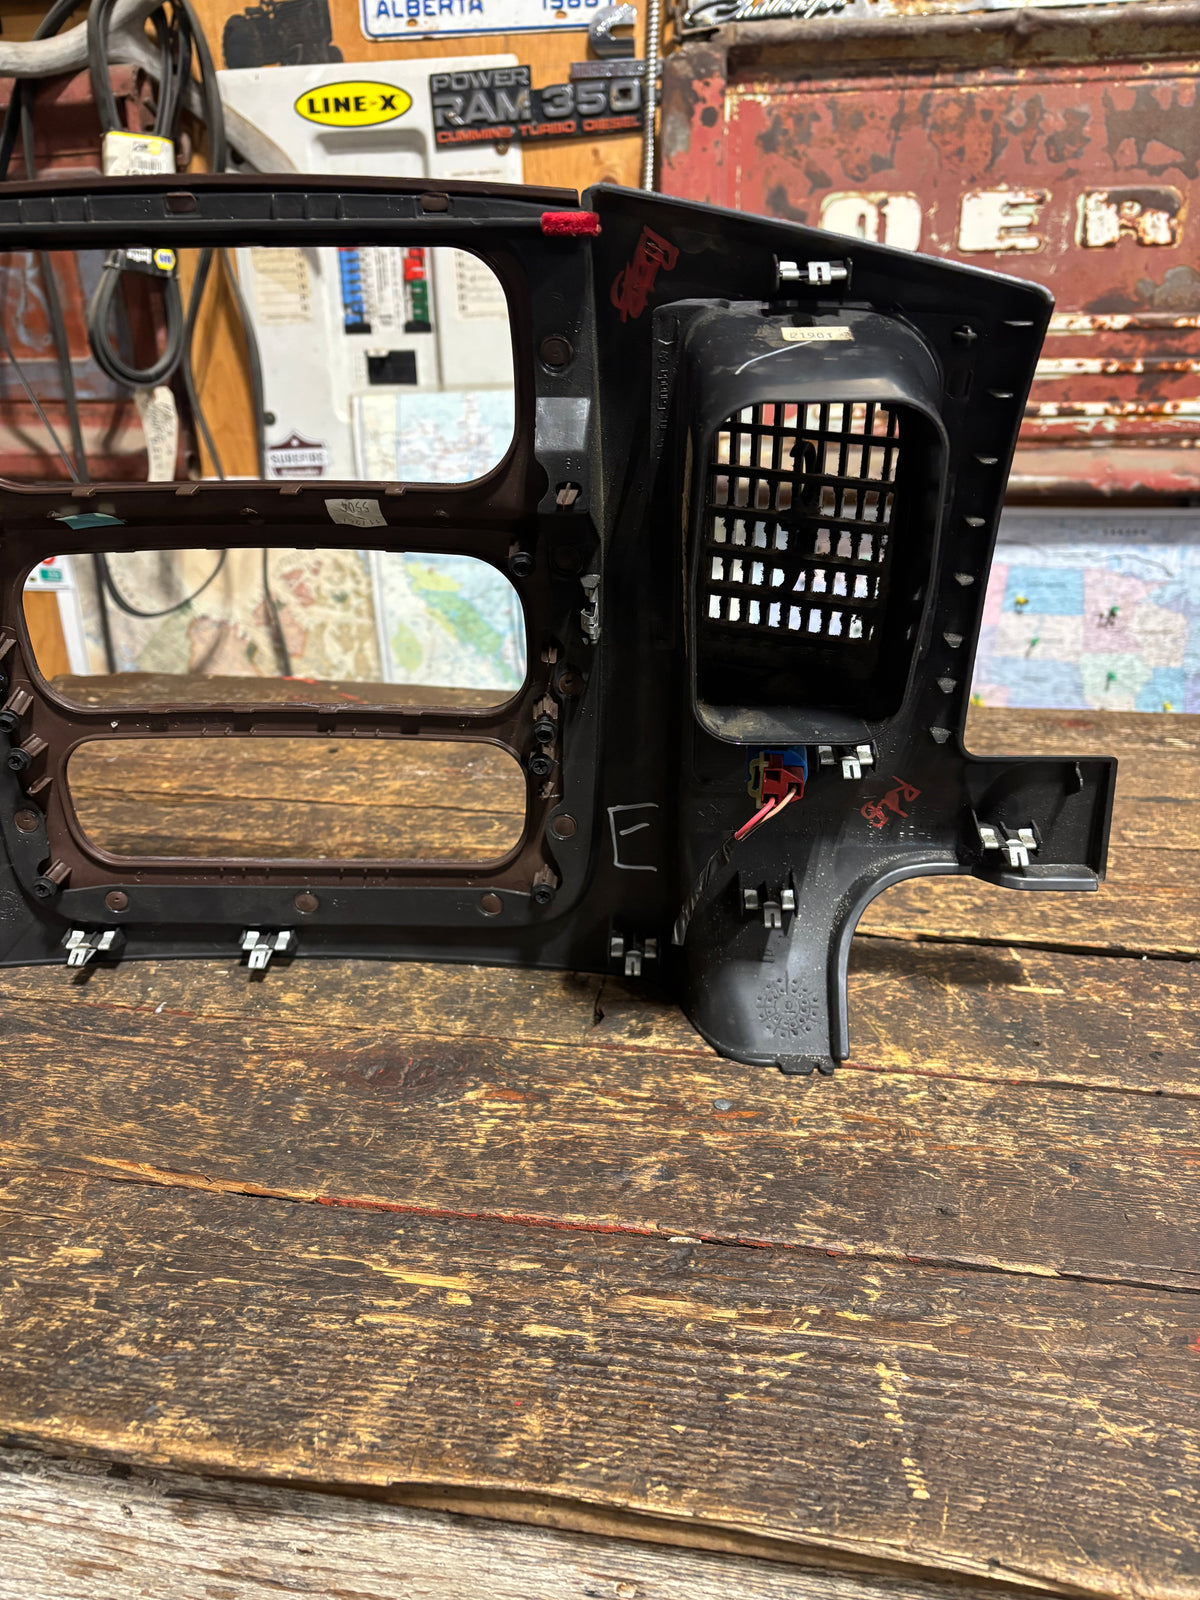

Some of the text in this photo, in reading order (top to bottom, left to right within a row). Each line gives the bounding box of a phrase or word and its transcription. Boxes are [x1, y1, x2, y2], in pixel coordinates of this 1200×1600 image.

[432, 67, 529, 93] POWER
[432, 79, 642, 127] RAM 350
[436, 115, 642, 144] CUMMINS TURBO DIESEL
